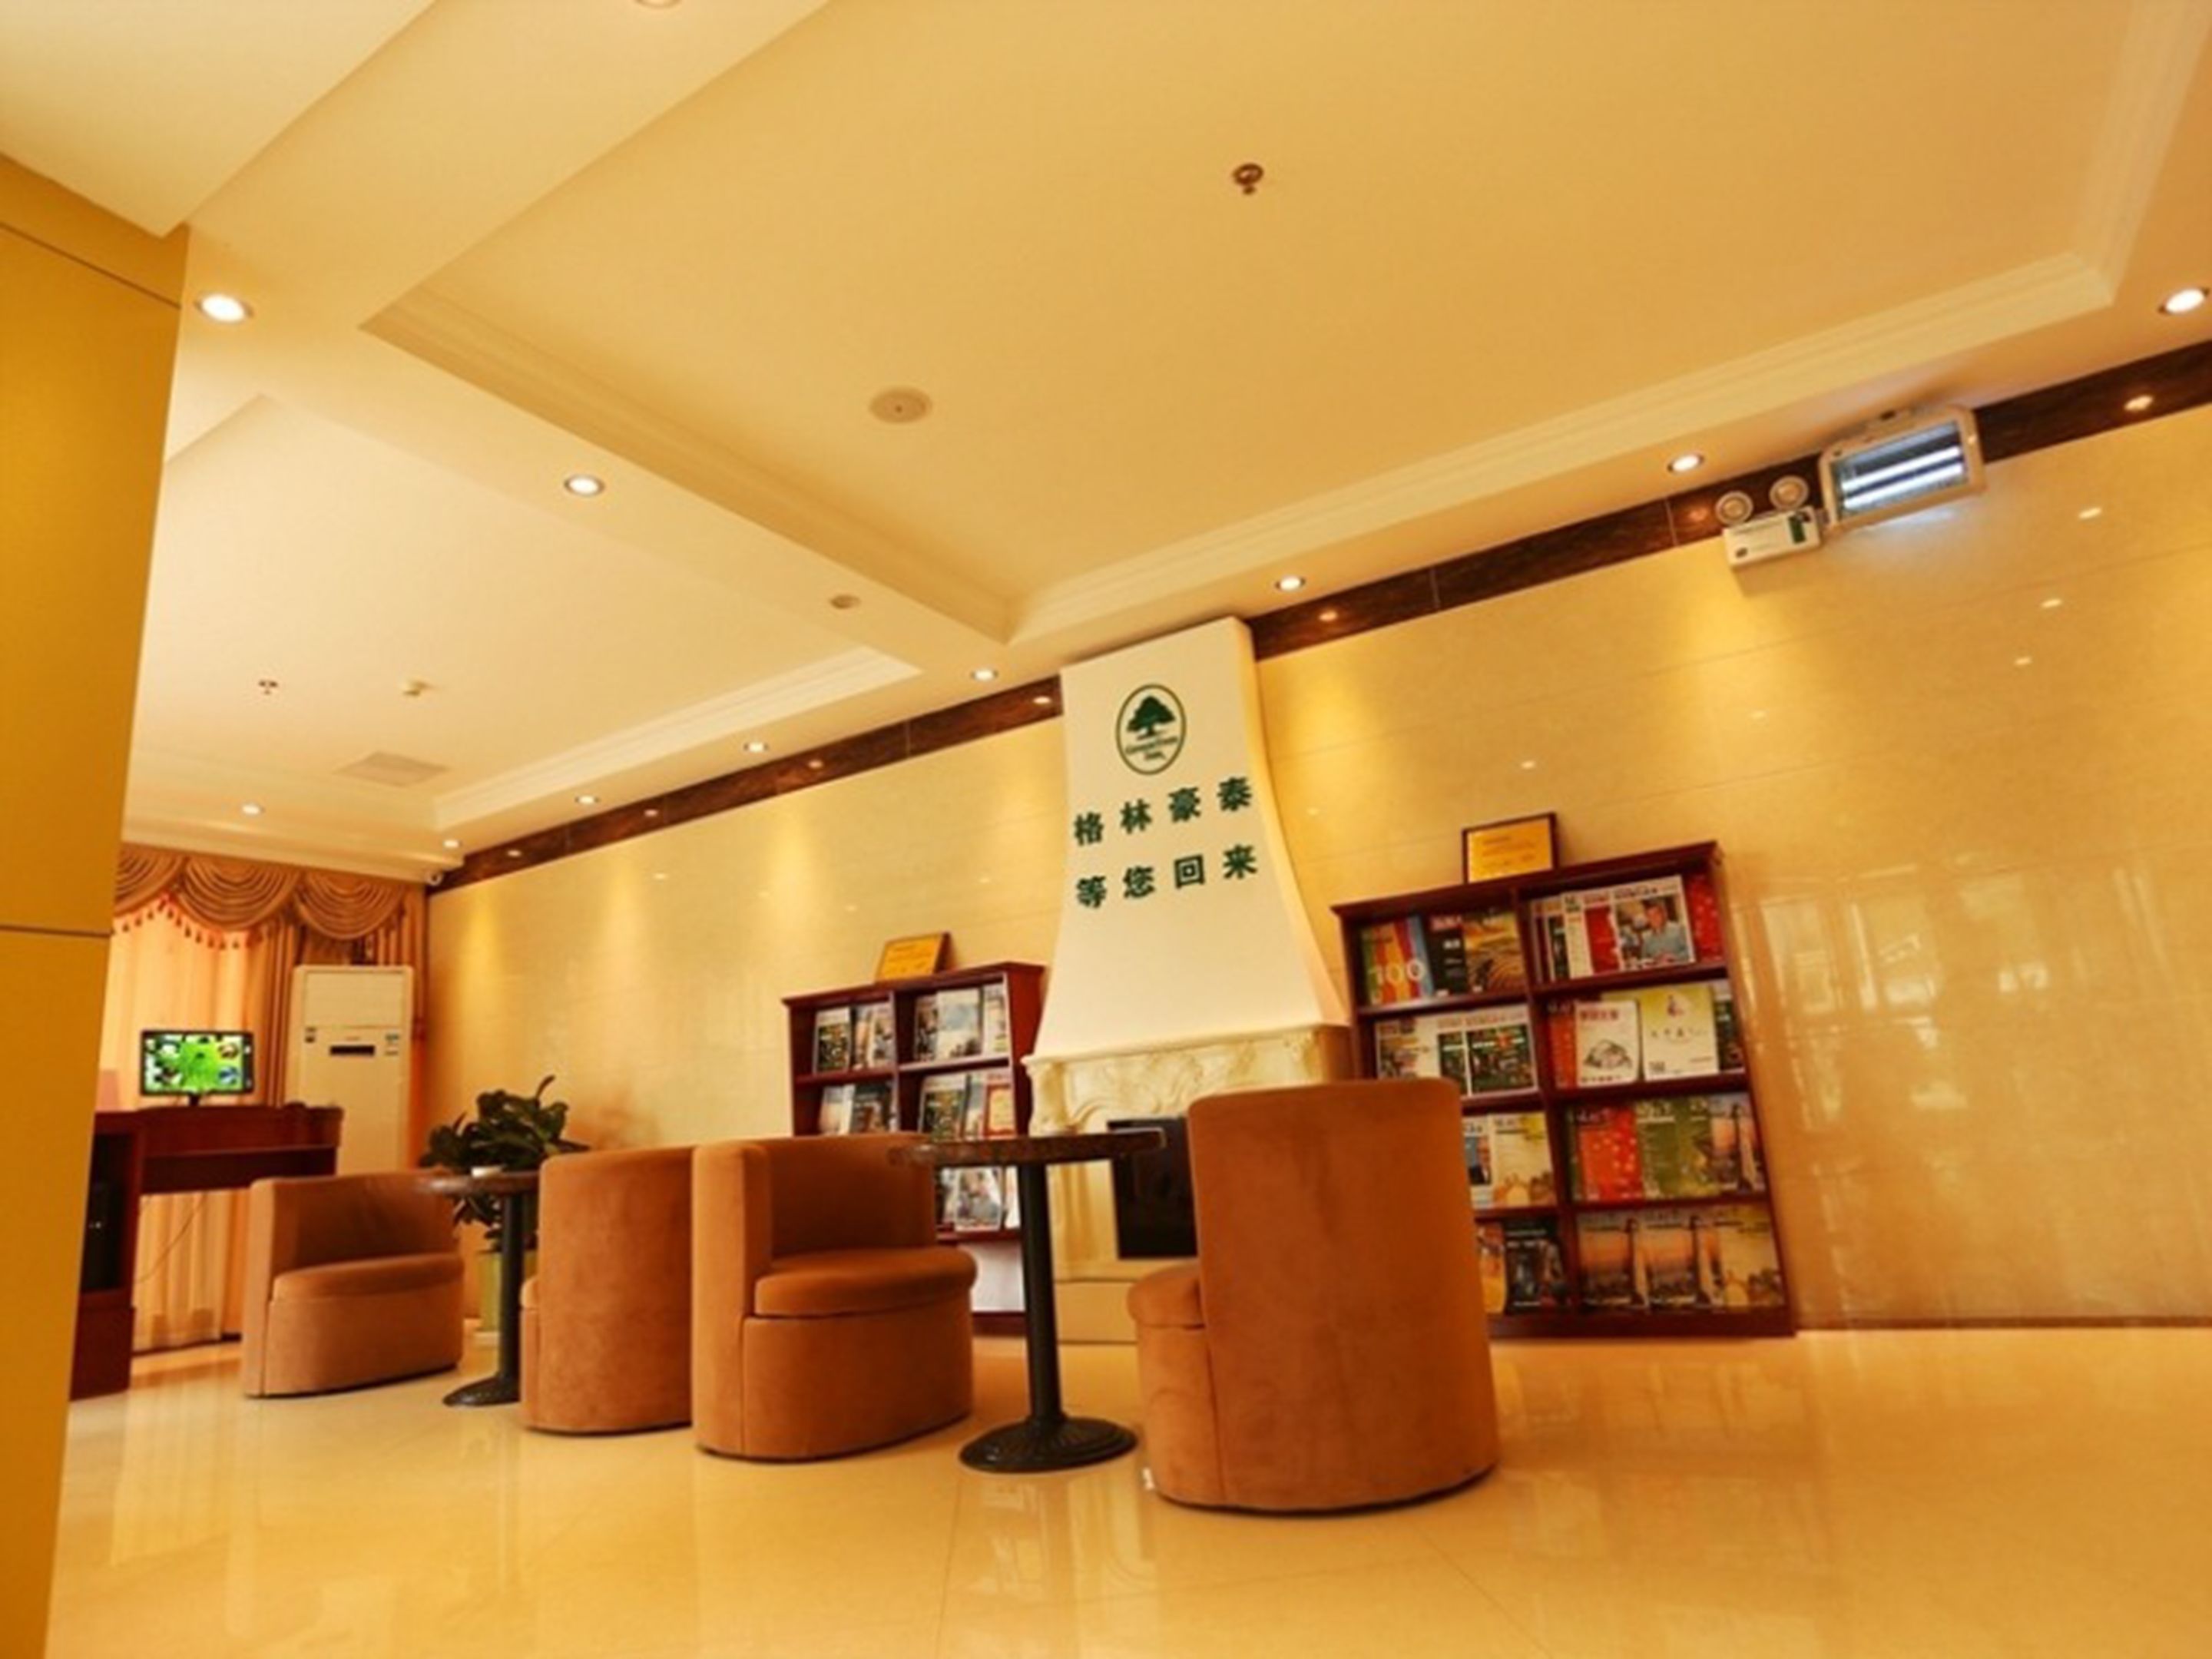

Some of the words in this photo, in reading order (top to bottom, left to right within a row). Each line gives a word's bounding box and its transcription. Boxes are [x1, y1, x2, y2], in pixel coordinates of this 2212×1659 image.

[1074, 777, 1252, 846] 格林豪泰
[1076, 844, 1257, 909] 等您回来
